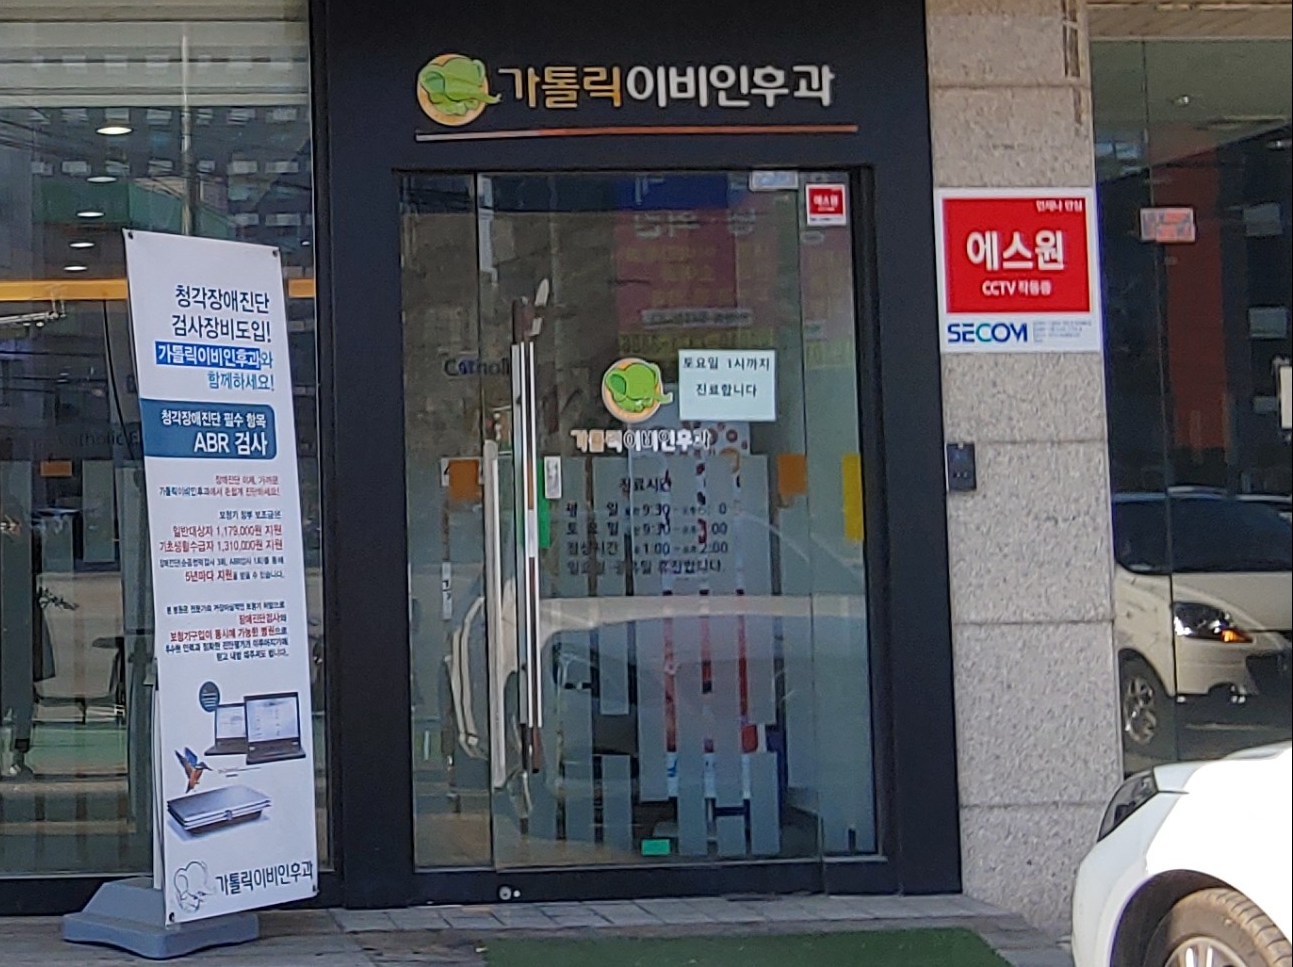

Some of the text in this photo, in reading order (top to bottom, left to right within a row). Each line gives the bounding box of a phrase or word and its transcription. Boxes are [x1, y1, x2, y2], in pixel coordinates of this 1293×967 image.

[499, 64, 836, 108] 가톨릭이비인후과
[966, 231, 1065, 271] 에스원
[175, 284, 270, 314] 청각장애진단
[982, 281, 1016, 296] CCTV
[172, 314, 272, 343] 검사장비도입!
[947, 322, 1028, 343] SECOM
[682, 356, 771, 371] 토요일 1시까지
[208, 371, 275, 391] 함께하세요!
[694, 382, 757, 398] 진료합니다
[161, 409, 267, 429] 청각장애진단 필수 항목
[194, 432, 268, 455] ABR 검사
